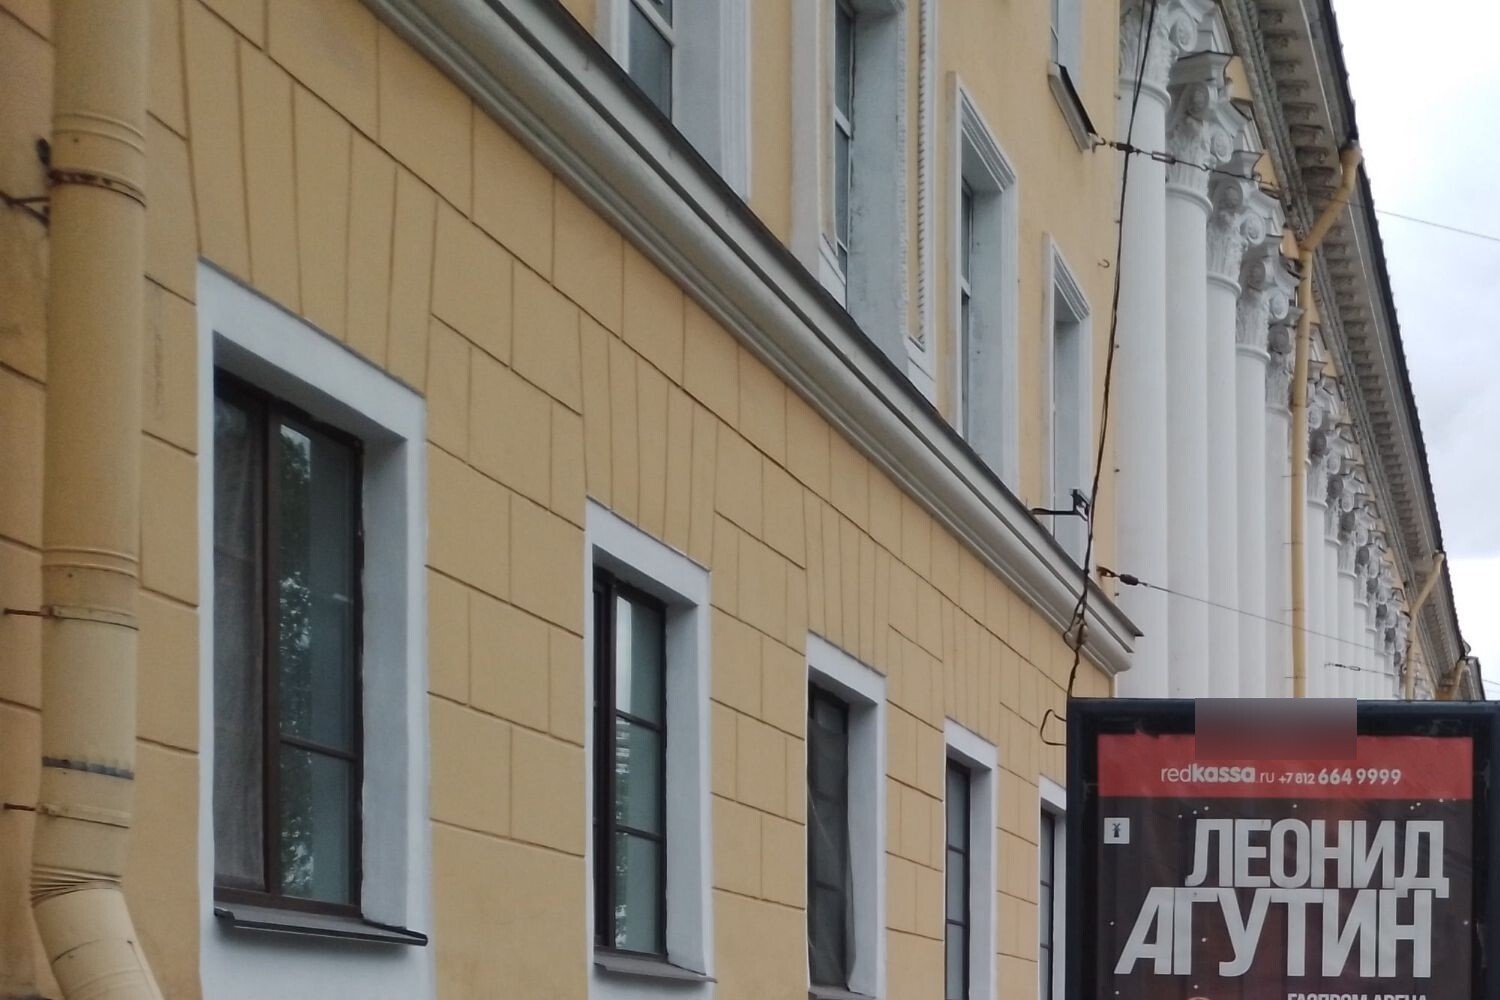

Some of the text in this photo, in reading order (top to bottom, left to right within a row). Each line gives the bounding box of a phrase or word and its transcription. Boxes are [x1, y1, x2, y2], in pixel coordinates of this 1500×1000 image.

[1295, 773, 1315, 785] 812
[1318, 768, 1352, 785] 664
[1356, 769, 1402, 785] 9999
[1185, 818, 1450, 898] ЛЕОНИД
[1113, 887, 1432, 978] АГУТИН
